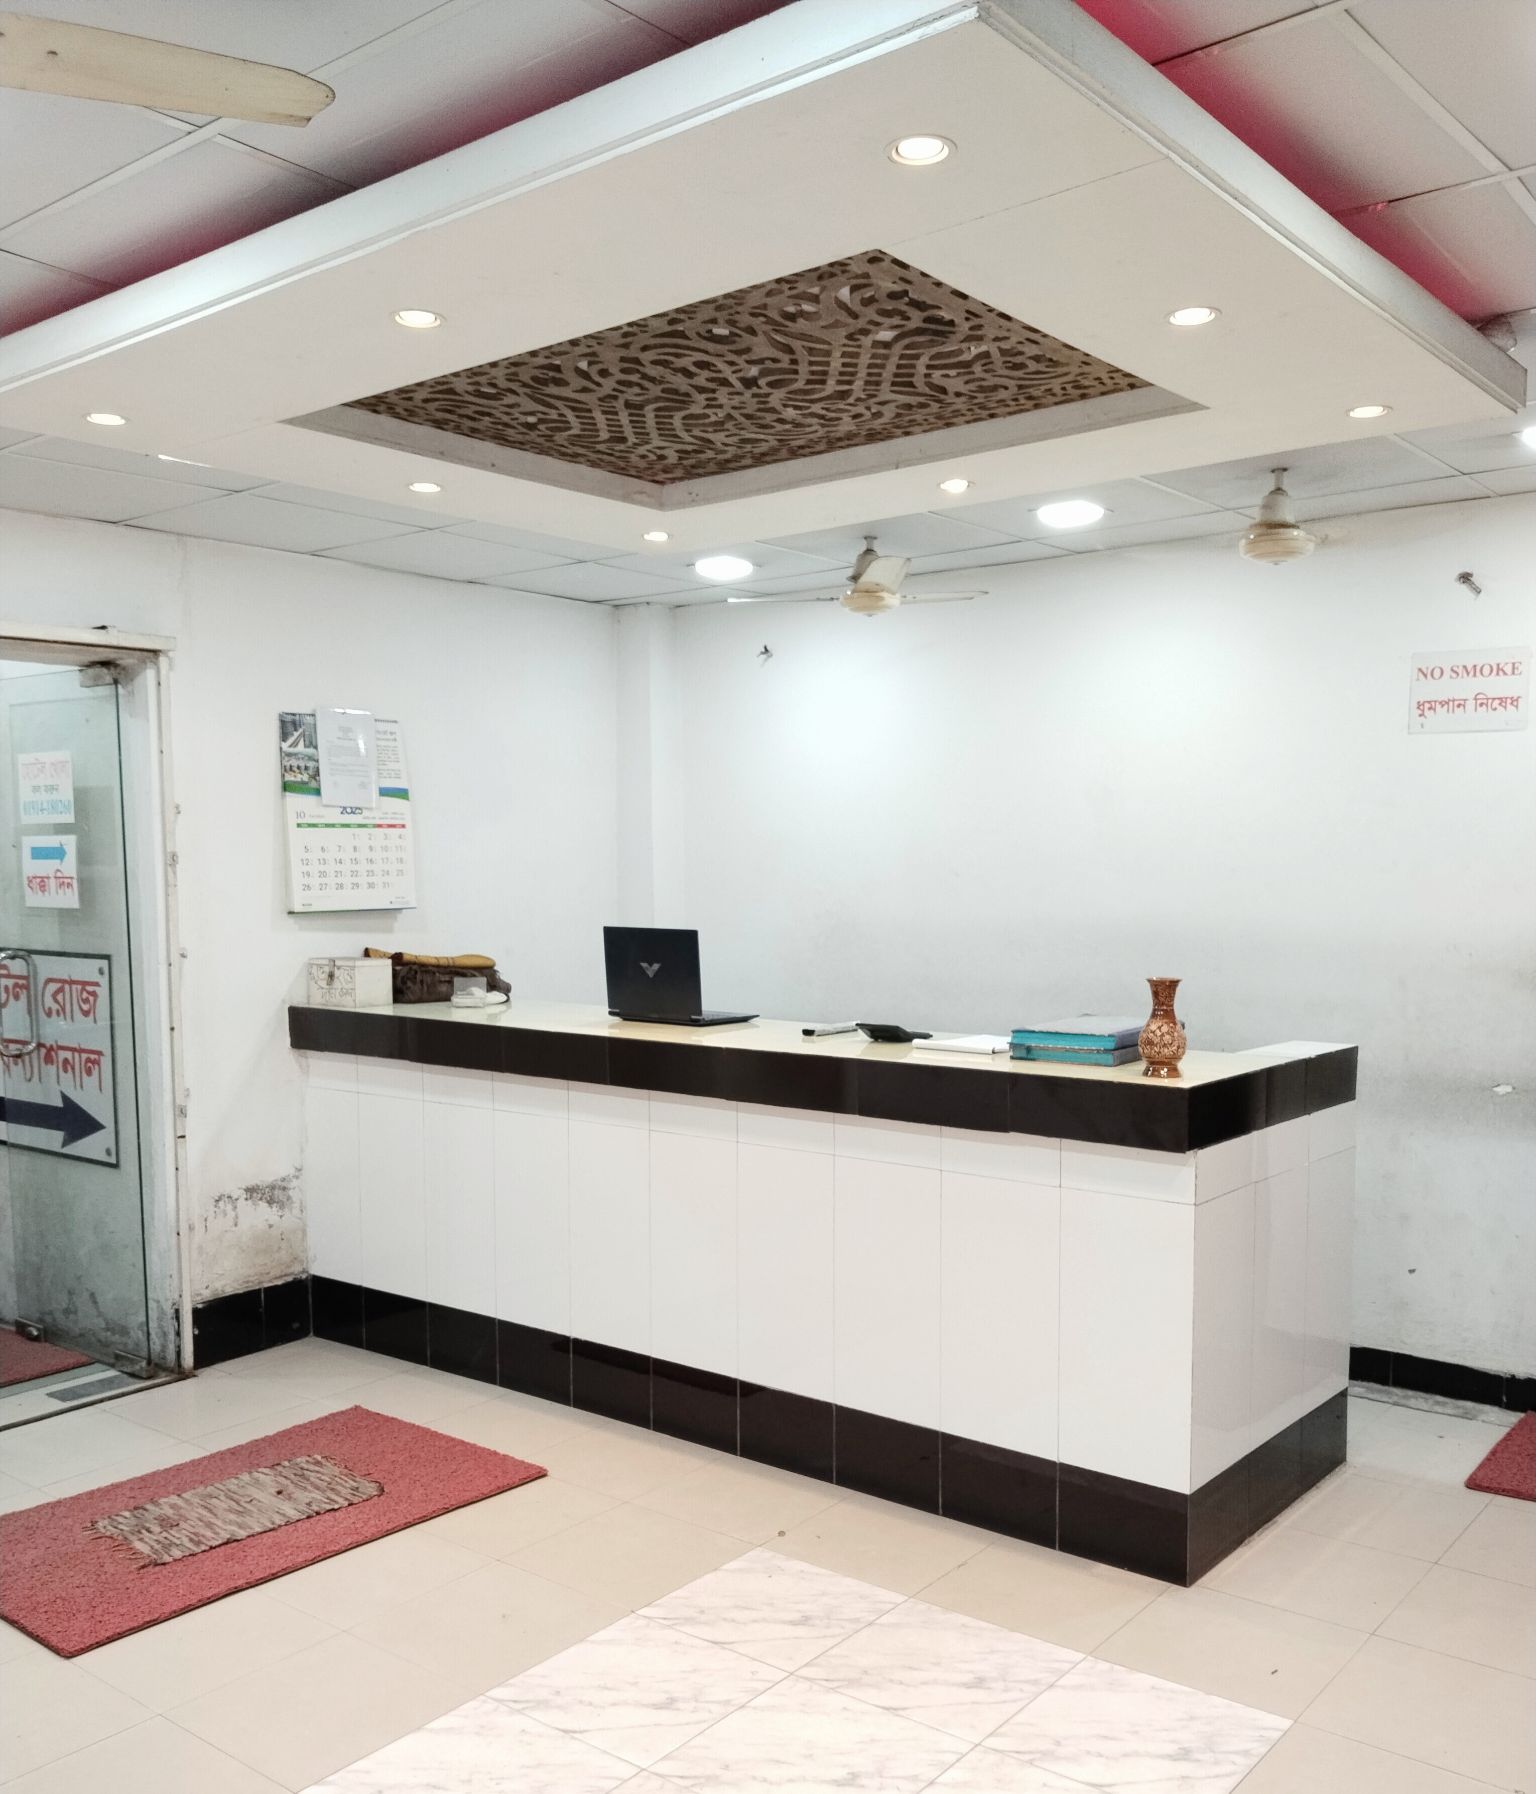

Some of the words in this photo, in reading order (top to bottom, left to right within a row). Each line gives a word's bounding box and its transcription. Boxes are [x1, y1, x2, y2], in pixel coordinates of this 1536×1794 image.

[1416, 666, 1444, 681] NO
[1450, 661, 1522, 679] SMOKE
[1416, 696, 1469, 719] ধুমপান
[1473, 692, 1522, 712] নিষেধ
[296, 811, 305, 819] 10
[340, 807, 363, 815] 2025
[54, 868, 74, 896] দিন
[319, 883, 328, 891] 27
[42, 975, 102, 1024] রোজ
